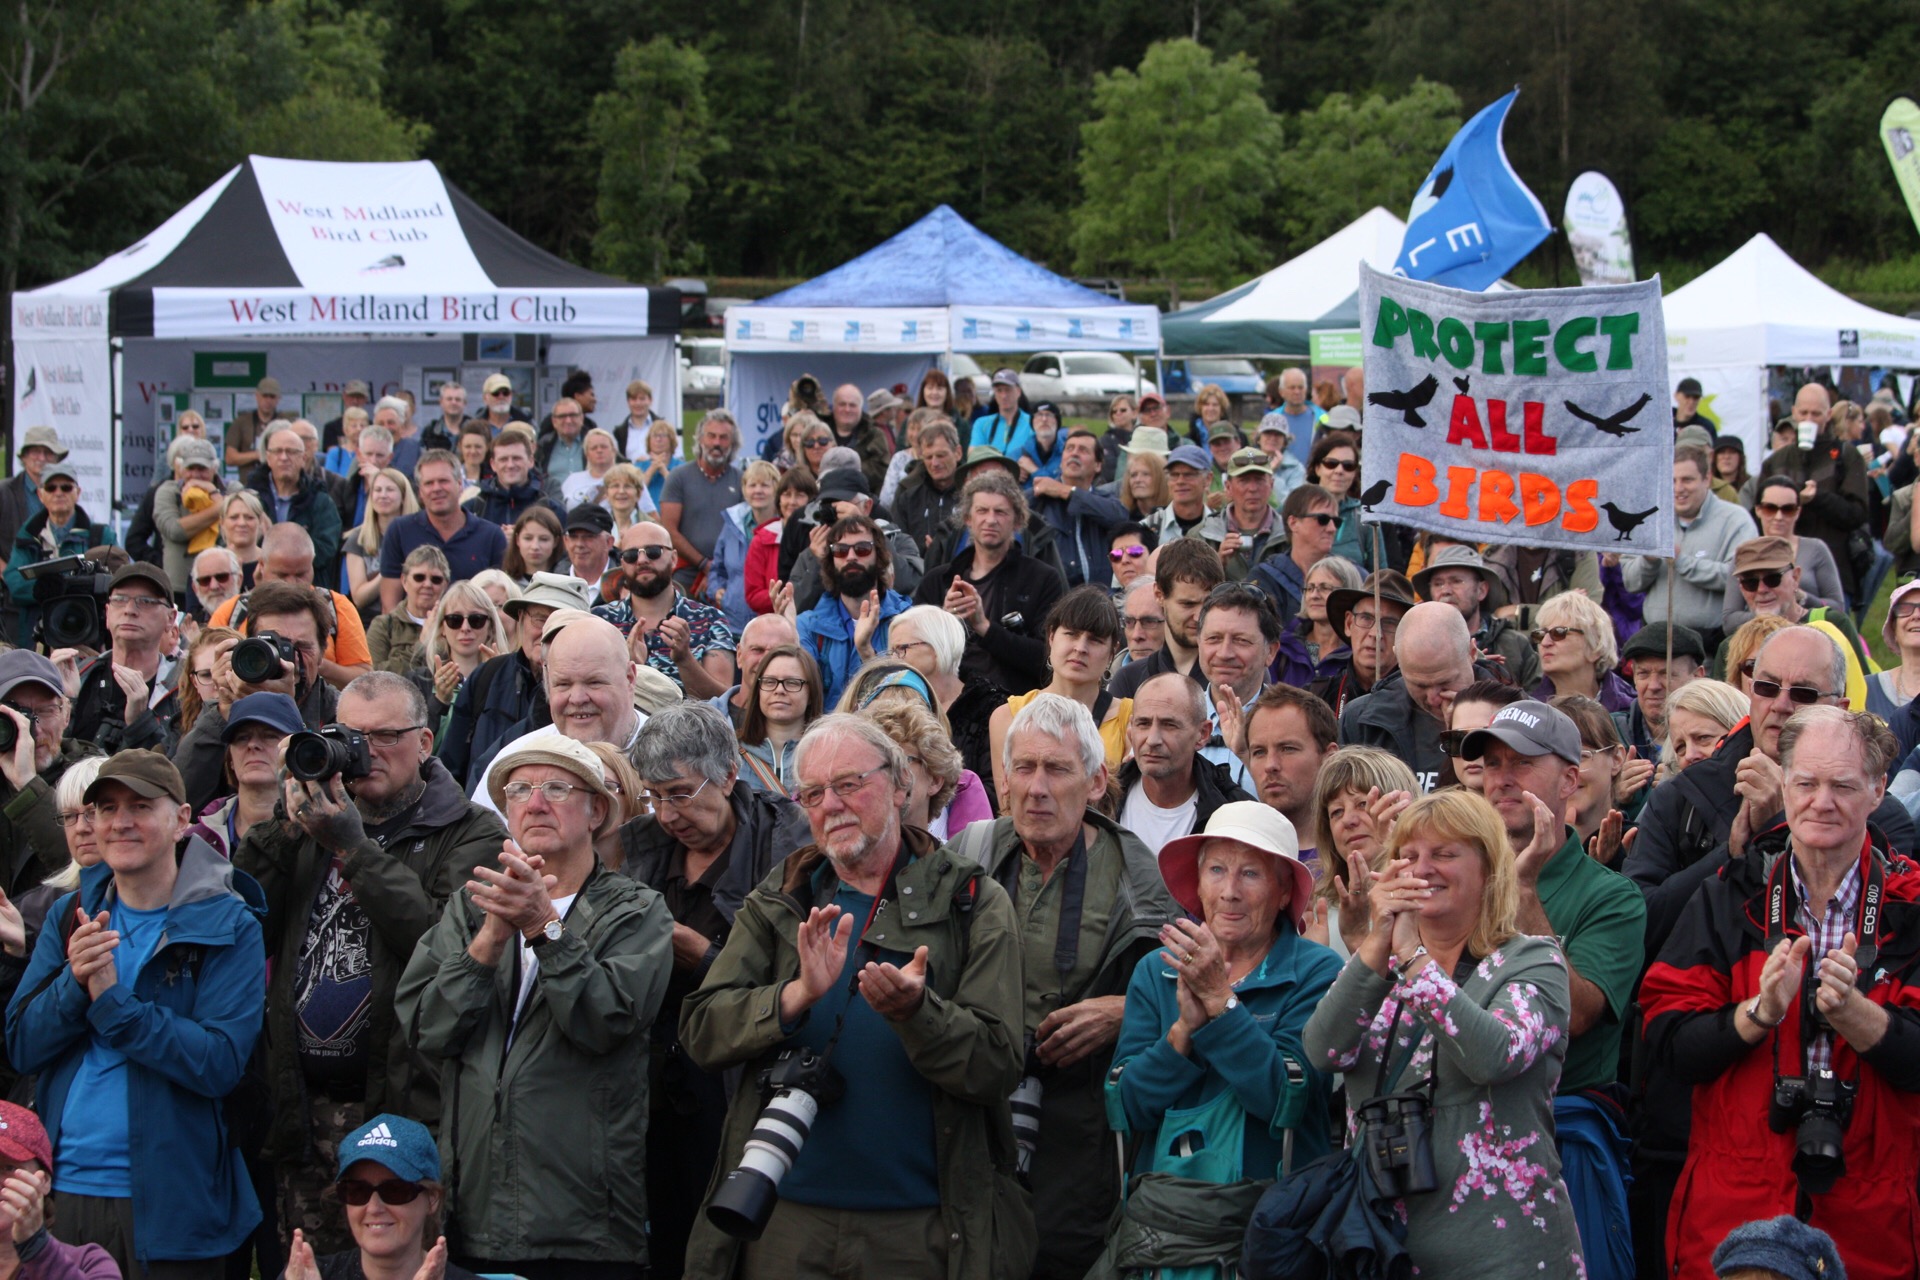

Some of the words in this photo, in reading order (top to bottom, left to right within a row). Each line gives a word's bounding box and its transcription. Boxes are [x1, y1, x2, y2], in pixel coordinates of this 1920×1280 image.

[276, 199, 334, 220] West
[342, 202, 444, 222] Midland
[311, 225, 362, 243] Bird
[369, 226, 428, 244] Club
[17, 305, 34, 327] West
[35, 304, 66, 327] Midland
[67, 304, 83, 327] Bird
[84, 304, 103, 326] Club
[229, 298, 298, 323] West
[308, 295, 429, 322] Midland
[442, 295, 499, 321] Bird
[510, 296, 576, 323] Club
[1372, 295, 1640, 376] PROTECT
[1446, 394, 1557, 456] ALL
[1394, 452, 1599, 533] BIRDS
[1518, 711, 1541, 729] DAY
[1771, 884, 1782, 924] Canon
[1866, 884, 1879, 904] 80D
[1863, 906, 1877, 935] EOS
[357, 1137, 398, 1148] adidas
